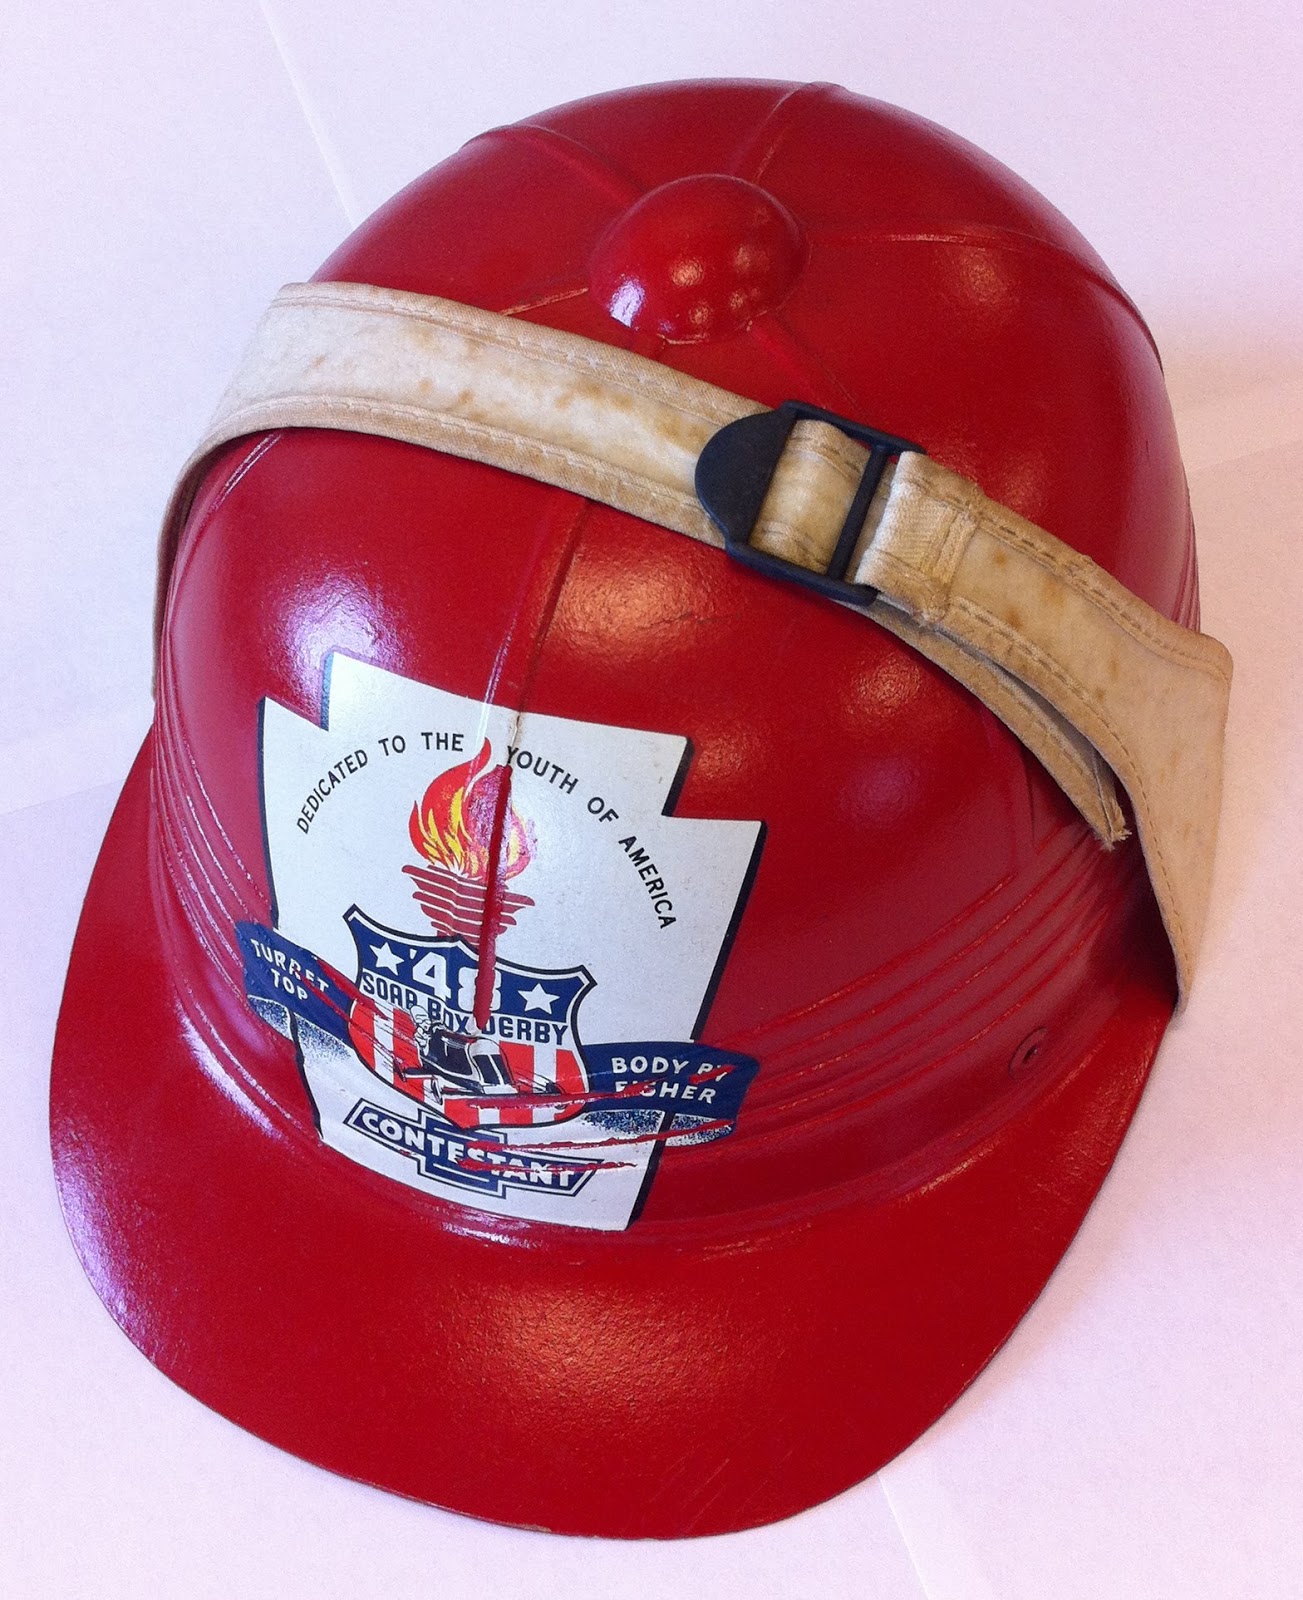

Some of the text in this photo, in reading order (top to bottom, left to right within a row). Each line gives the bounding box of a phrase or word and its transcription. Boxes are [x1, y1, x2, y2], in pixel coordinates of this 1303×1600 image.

[296, 732, 677, 930] DEDICATED TO THE YOUTH OF AMERICA
[250, 938, 329, 992] TURRET
[270, 968, 308, 1001] TOP
[409, 948, 501, 1012] '48
[361, 971, 569, 1046] SOAP BOX DERBY
[611, 1055, 689, 1074] BODY
[360, 1110, 577, 1188] CONTESTANT
